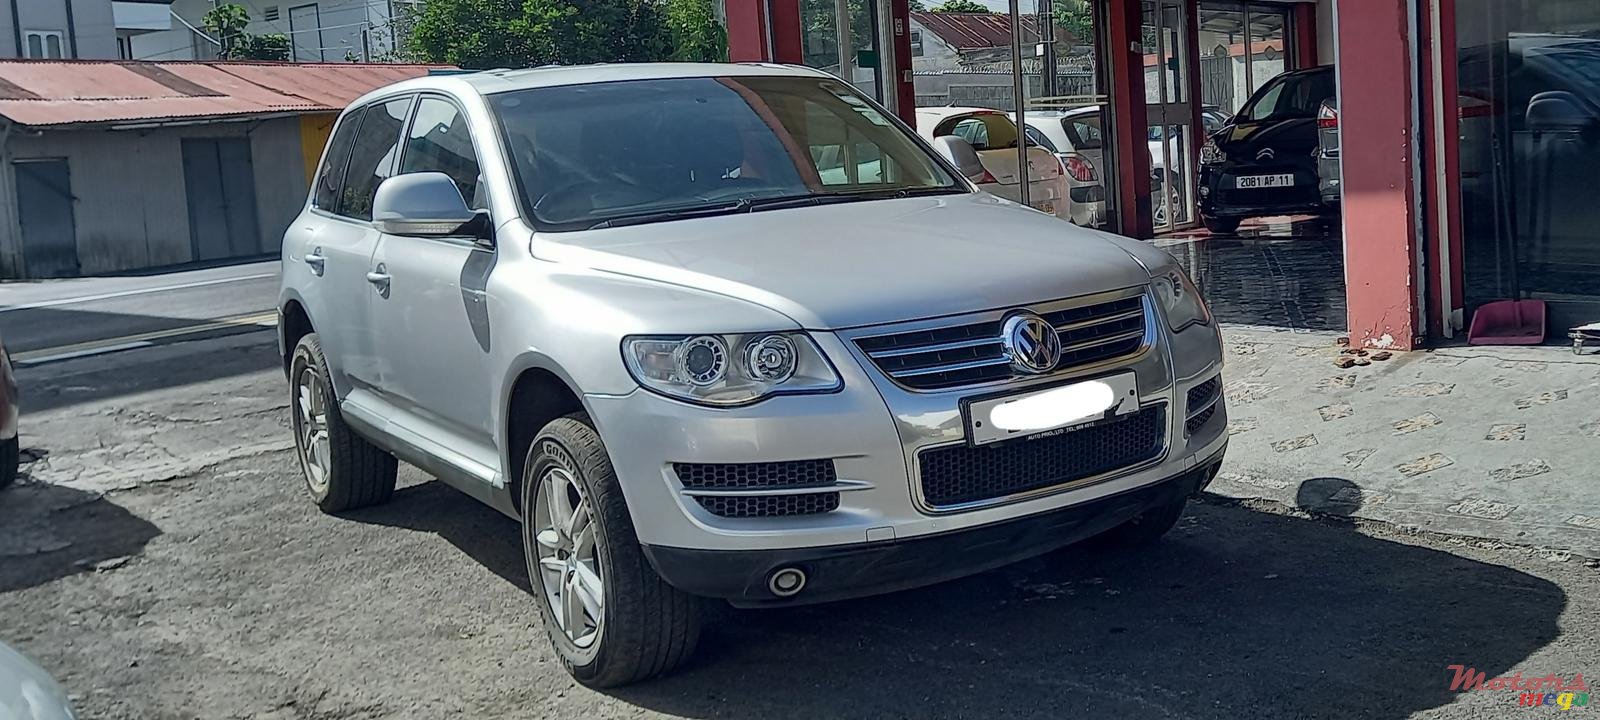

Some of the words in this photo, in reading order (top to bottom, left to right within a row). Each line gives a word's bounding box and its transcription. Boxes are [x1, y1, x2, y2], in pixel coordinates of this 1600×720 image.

[1240, 177, 1260, 187] 2081
[1265, 176, 1275, 186] AP
[1279, 175, 1289, 185] 11
